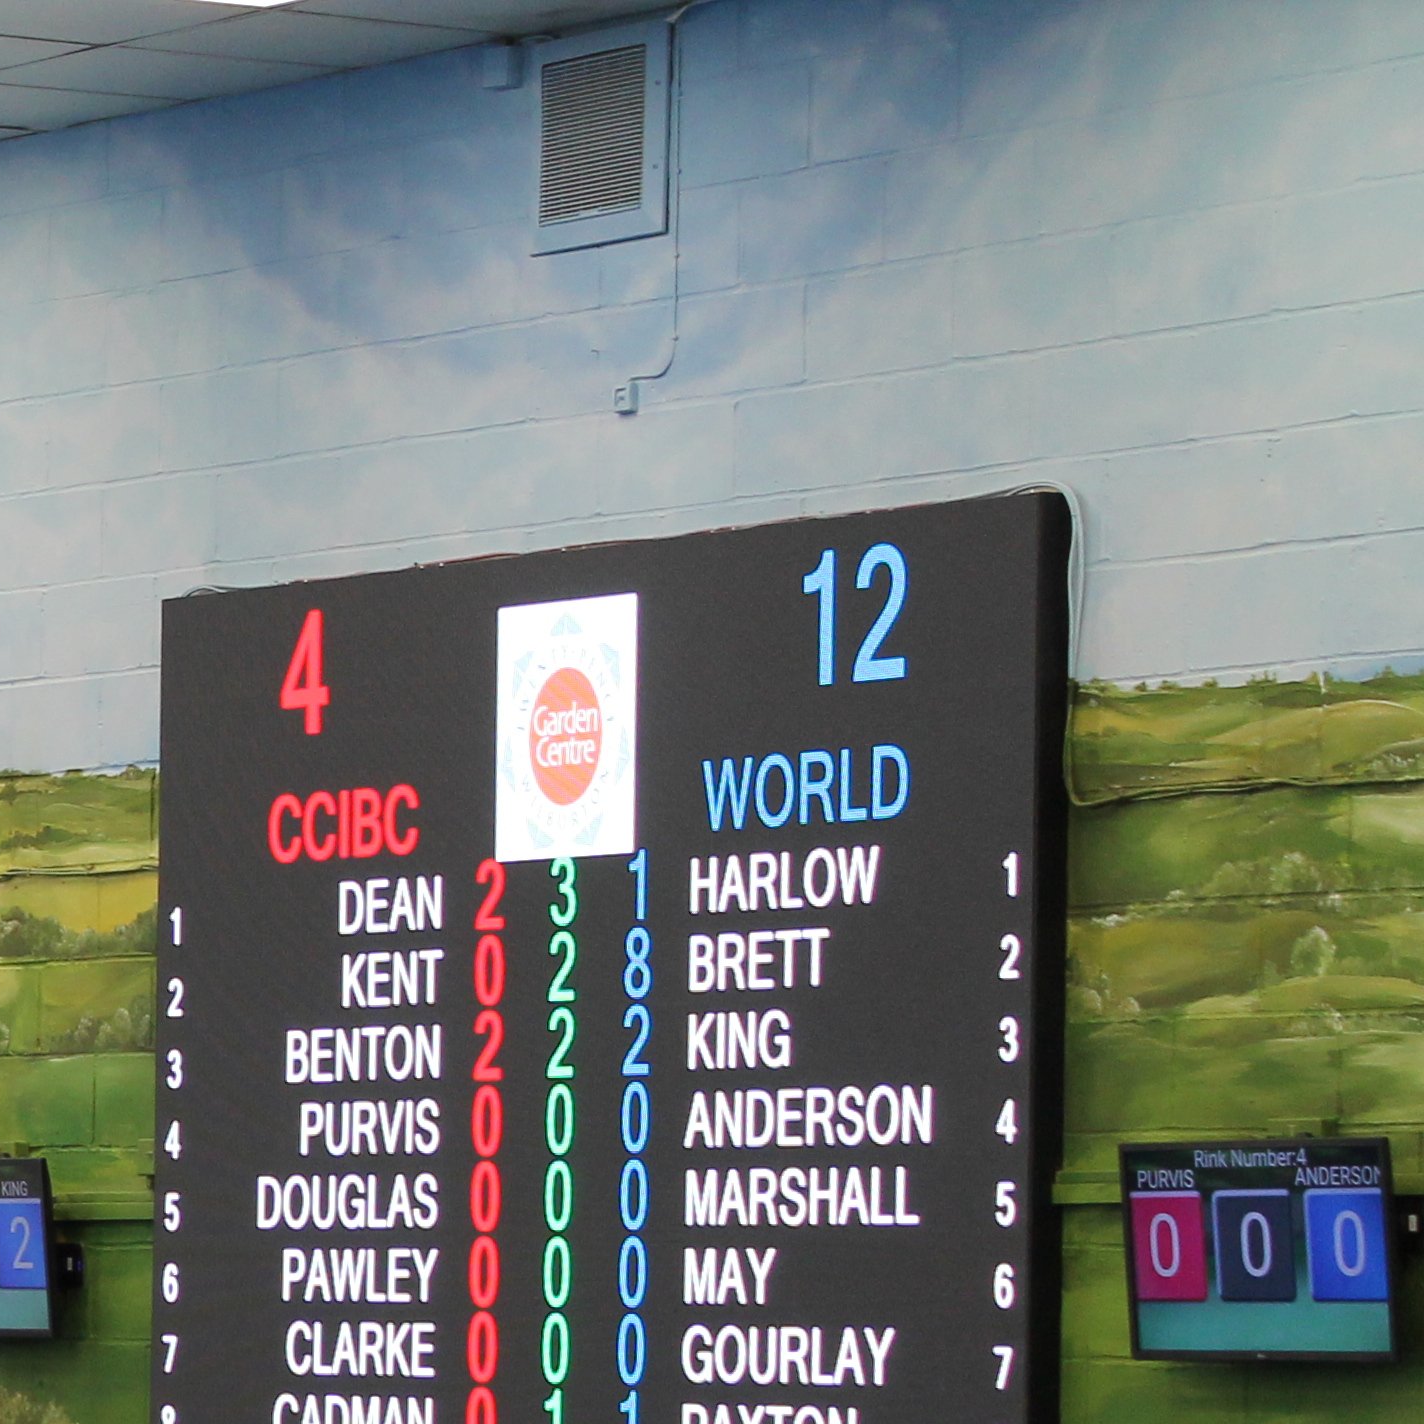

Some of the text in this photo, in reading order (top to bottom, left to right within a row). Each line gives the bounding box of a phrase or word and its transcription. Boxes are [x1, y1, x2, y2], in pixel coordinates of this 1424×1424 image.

[278, 542, 910, 736] 4 12
[533, 700, 599, 737] Garden
[535, 736, 596, 768] Centre
[267, 783, 421, 865] CCIBC
[702, 743, 912, 832] WORLD
[169, 844, 1018, 946] 1 DEAN 2 3 1 HARLOW 1
[167, 925, 1021, 1018] 2 KENT 0 2 8 BRETT 2
[166, 1003, 1020, 1089] 3 BENTON 2 2 2 KING 3
[164, 1081, 1018, 1160] 4 PURVIS 0 0 0 ANDERSON 4
[2, 1180, 28, 1197] KING
[163, 1158, 1017, 1234] 5 DOUGLAS 0 0 0 MARSHALL 5
[1137, 1169, 1195, 1189] PURVIS
[1194, 1150, 1226, 1168] Rink
[10, 1216, 34, 1269] 2
[162, 1234, 1015, 1309] 6 PAWLEY 0 0 0 MAY 6
[1149, 1210, 1365, 1277] 0 0 0
[161, 1310, 1014, 1390] 7 CLARKE 0 0 0 GOURLAY 7
